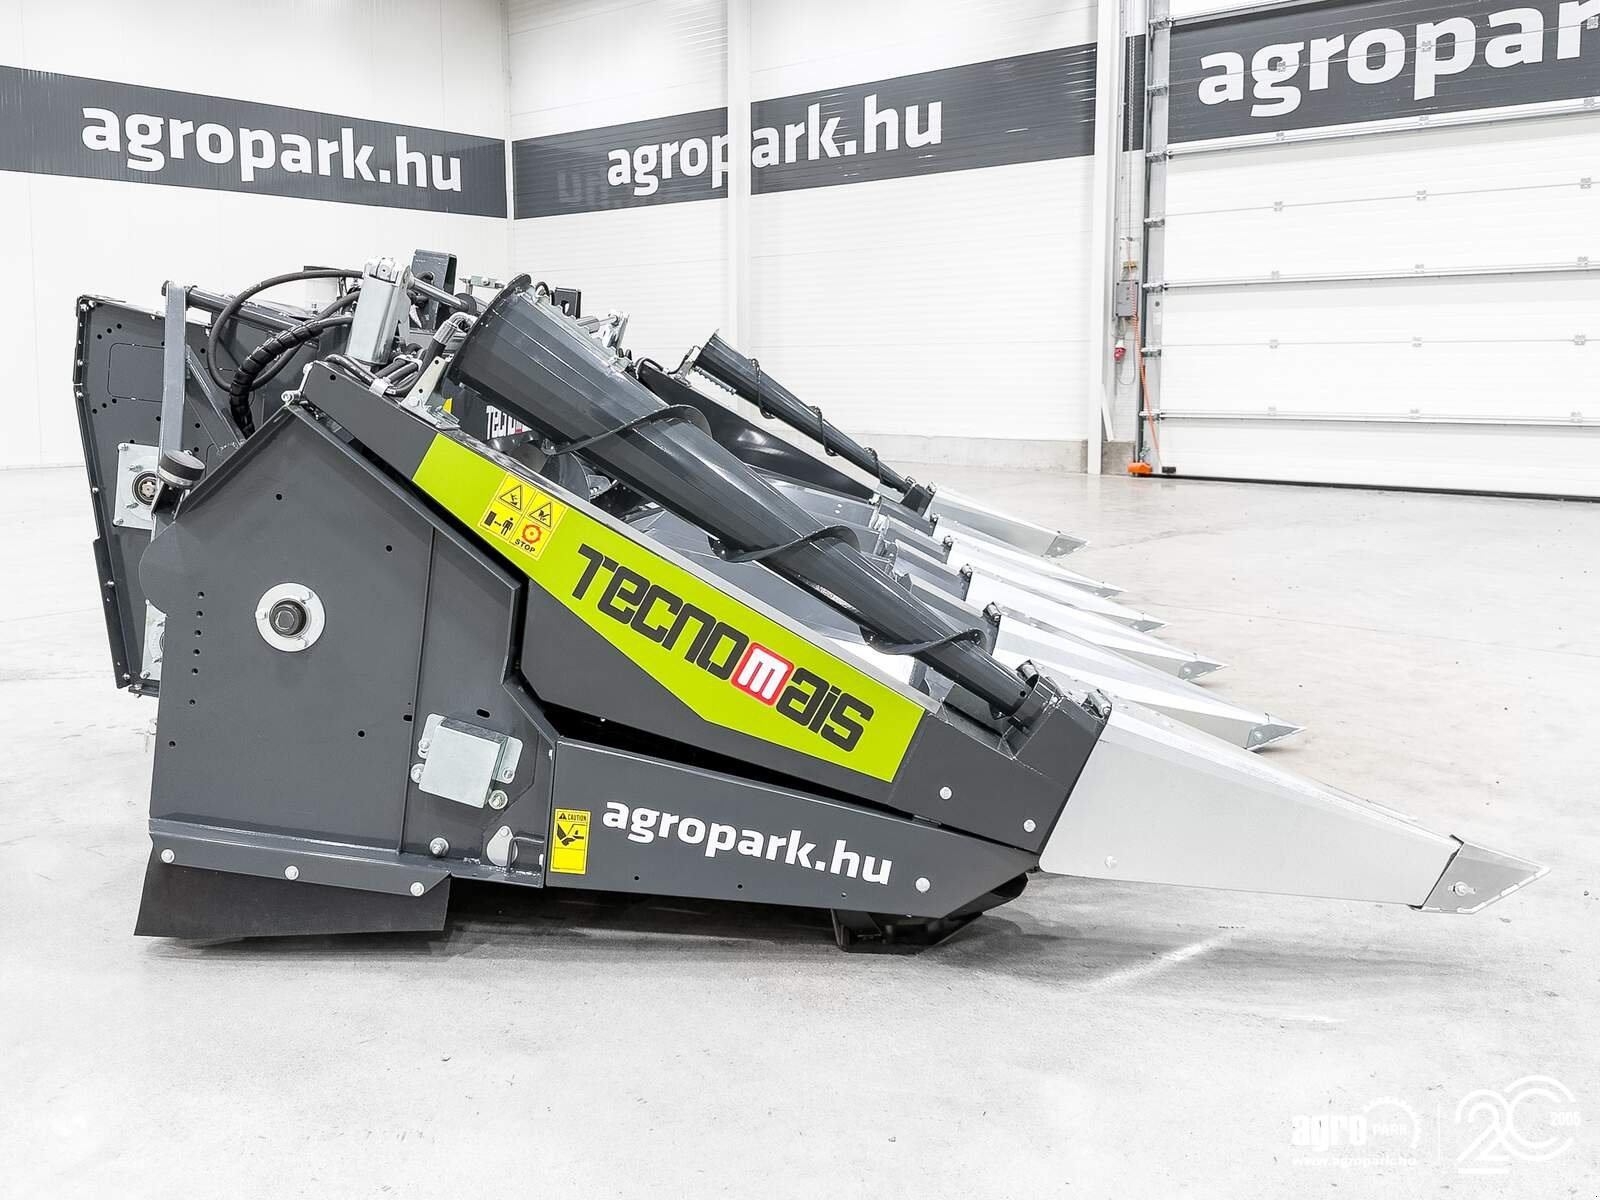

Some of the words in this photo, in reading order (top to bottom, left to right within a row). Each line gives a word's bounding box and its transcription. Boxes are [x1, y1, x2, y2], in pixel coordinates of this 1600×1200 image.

[81, 107, 463, 193] agropark.hu
[514, 538, 536, 553] STOP
[567, 813, 587, 821] CAUTION
[602, 801, 893, 886] agropark.hu
